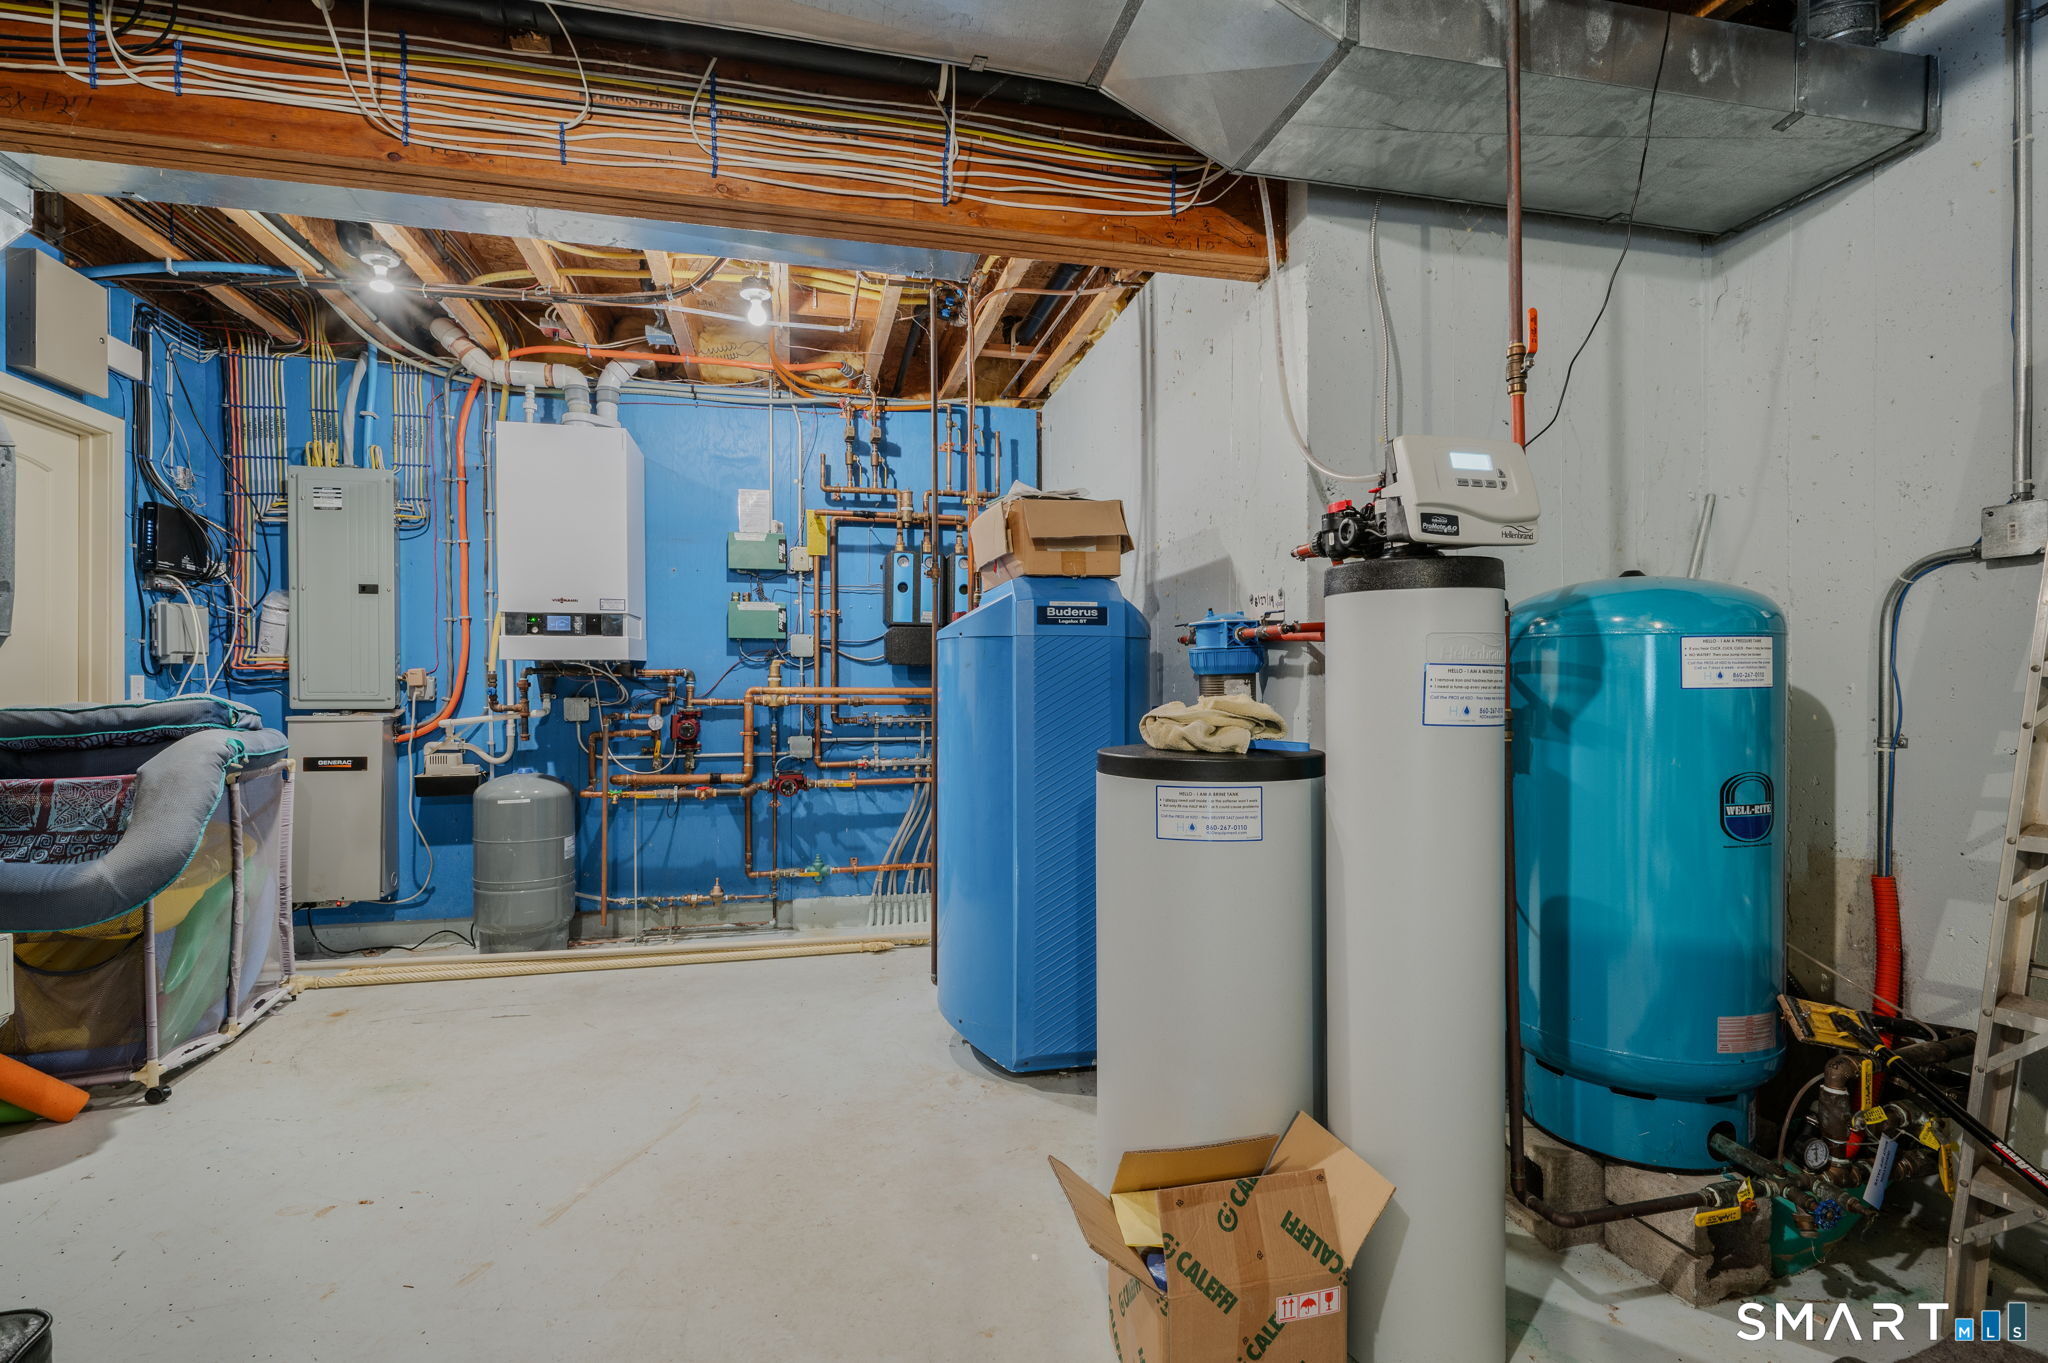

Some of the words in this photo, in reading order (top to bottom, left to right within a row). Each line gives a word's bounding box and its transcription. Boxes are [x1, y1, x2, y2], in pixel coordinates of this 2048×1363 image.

[1501, 530, 1534, 540] Hellenbrand
[1046, 607, 1098, 617] Buderus
[1725, 804, 1772, 816] WELL-RITE
[1279, 1209, 1344, 1274] CALEFFI
[1176, 1251, 1239, 1316] CALEFFI
